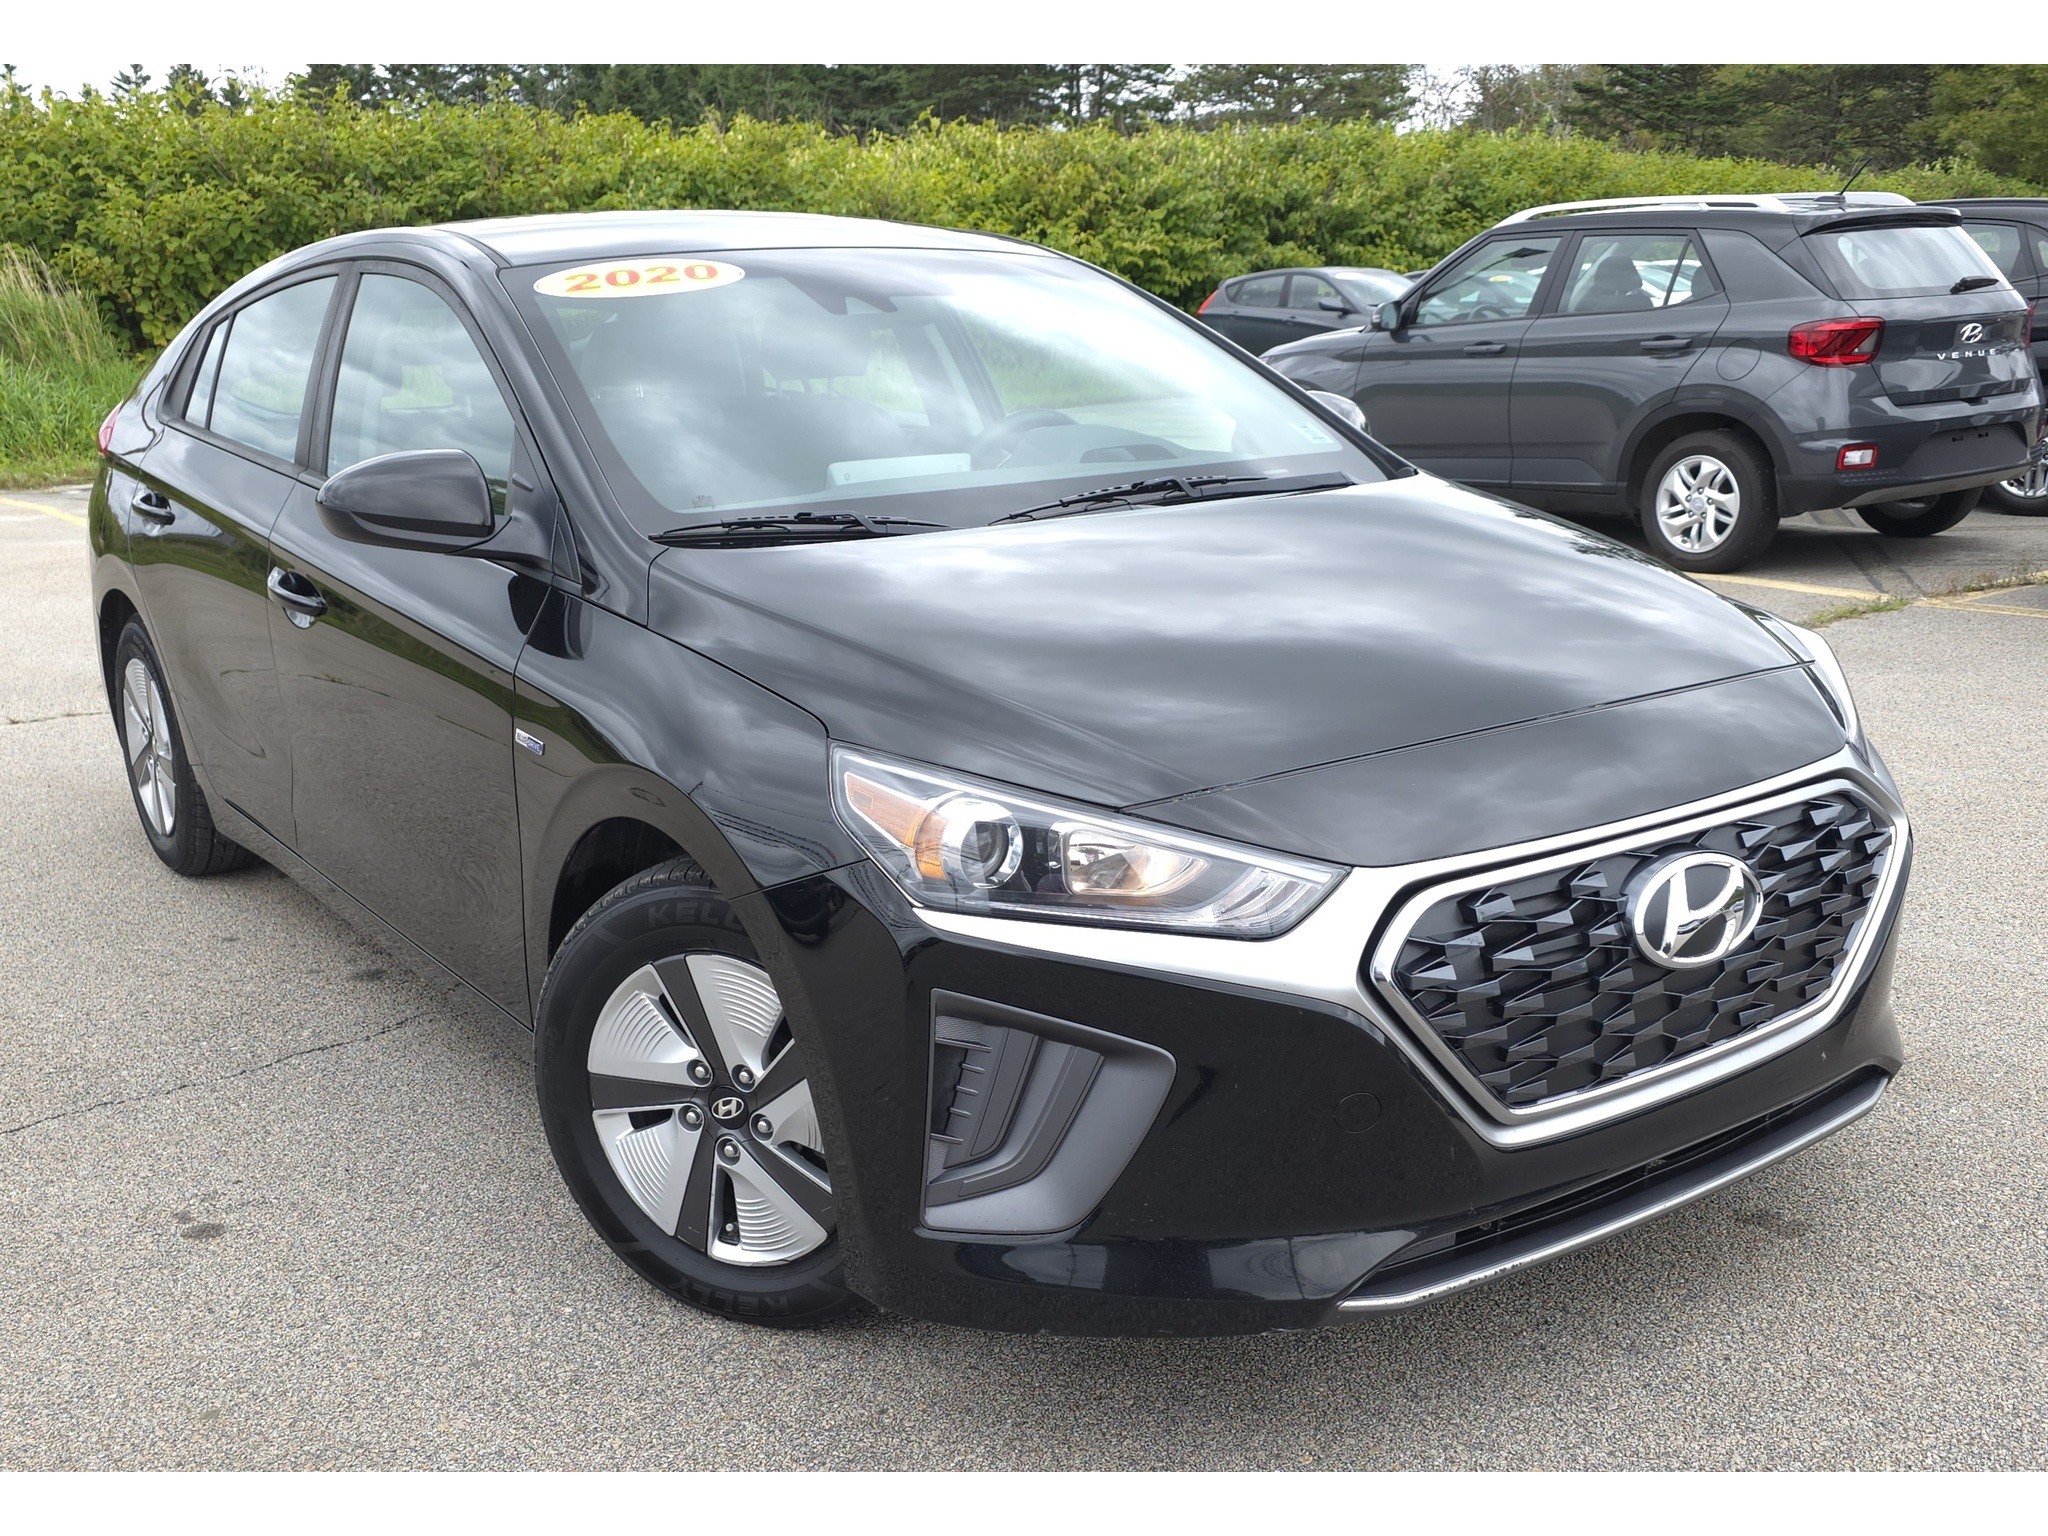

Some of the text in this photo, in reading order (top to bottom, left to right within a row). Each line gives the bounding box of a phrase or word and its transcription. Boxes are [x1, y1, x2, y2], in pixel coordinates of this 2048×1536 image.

[565, 264, 719, 292] 2020
[1937, 348, 1996, 360] VENUE
[669, 1277, 789, 1316] KELLY
